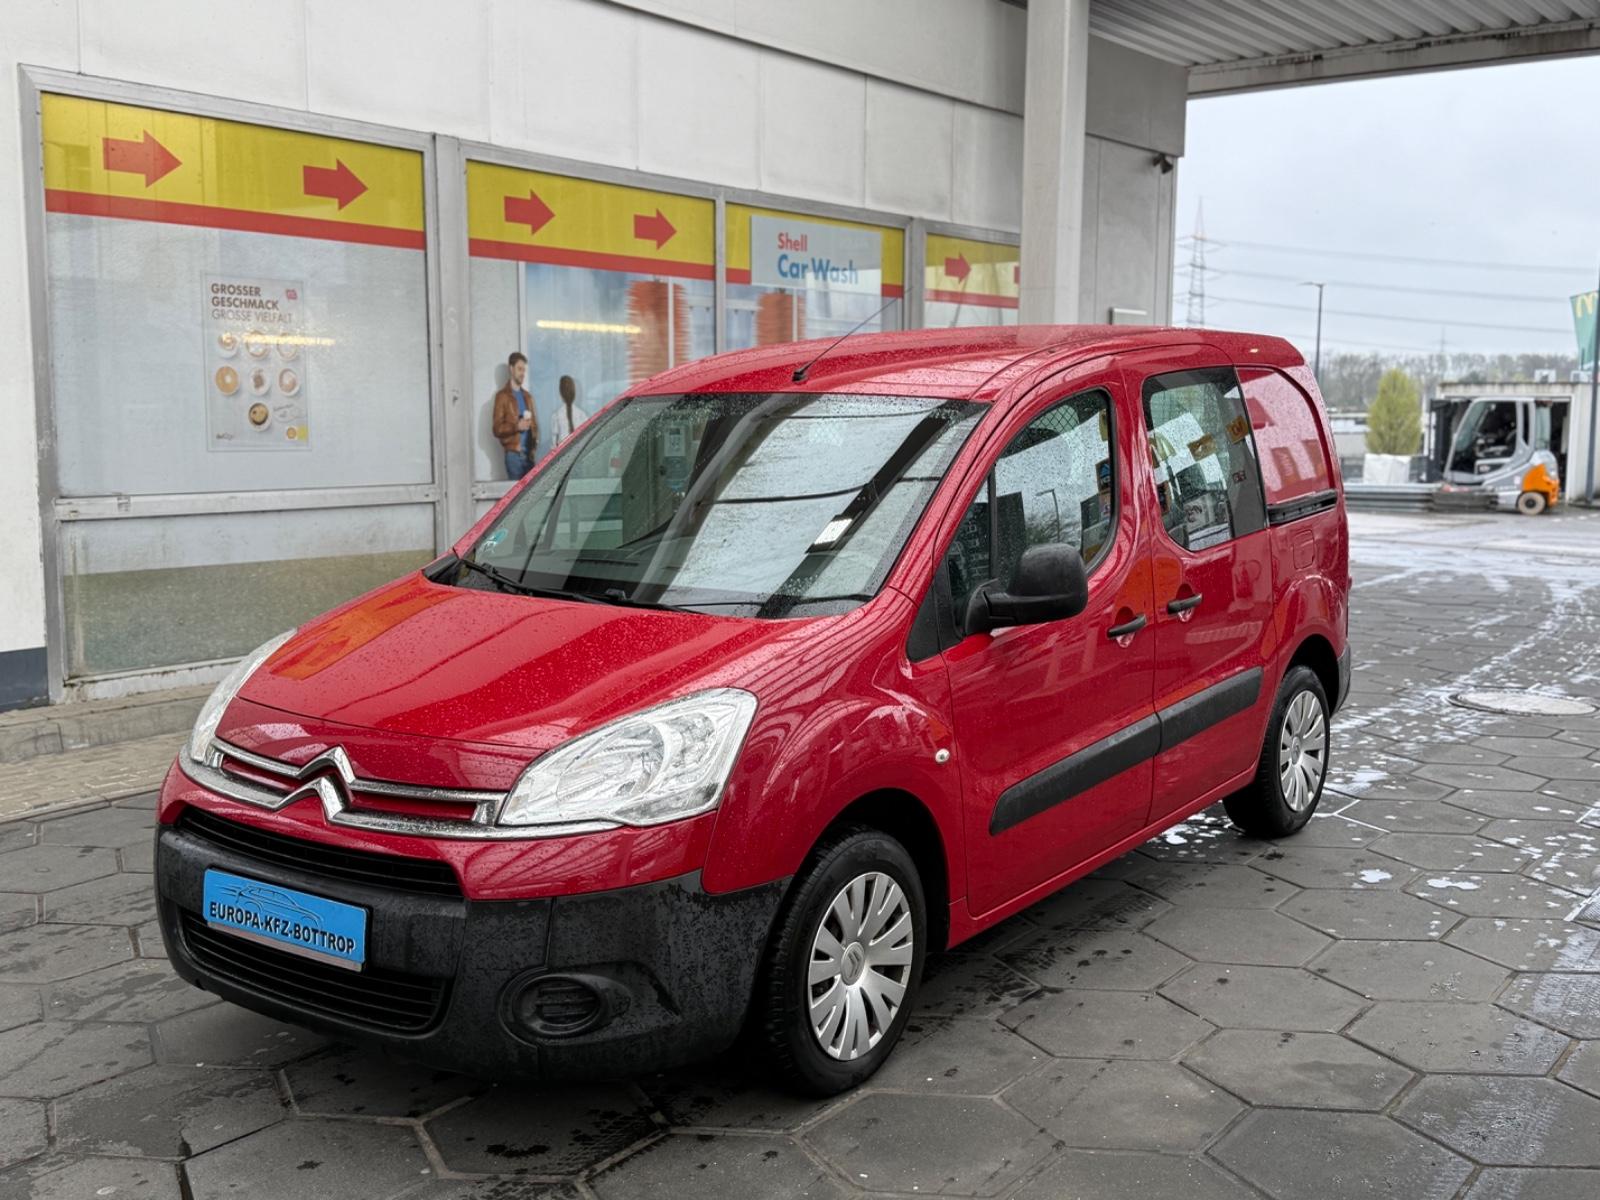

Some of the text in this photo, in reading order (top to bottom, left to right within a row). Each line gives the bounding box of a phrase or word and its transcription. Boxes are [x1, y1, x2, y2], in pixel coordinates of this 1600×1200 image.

[778, 232, 808, 252] Shell
[778, 254, 859, 284] Car Wash
[211, 283, 261, 297] GROSSER
[211, 296, 279, 310] GESCHMACK
[211, 309, 293, 324] GROSSE VIELFALT
[209, 901, 356, 955] EUROPA-KFZ-BOTTROP
